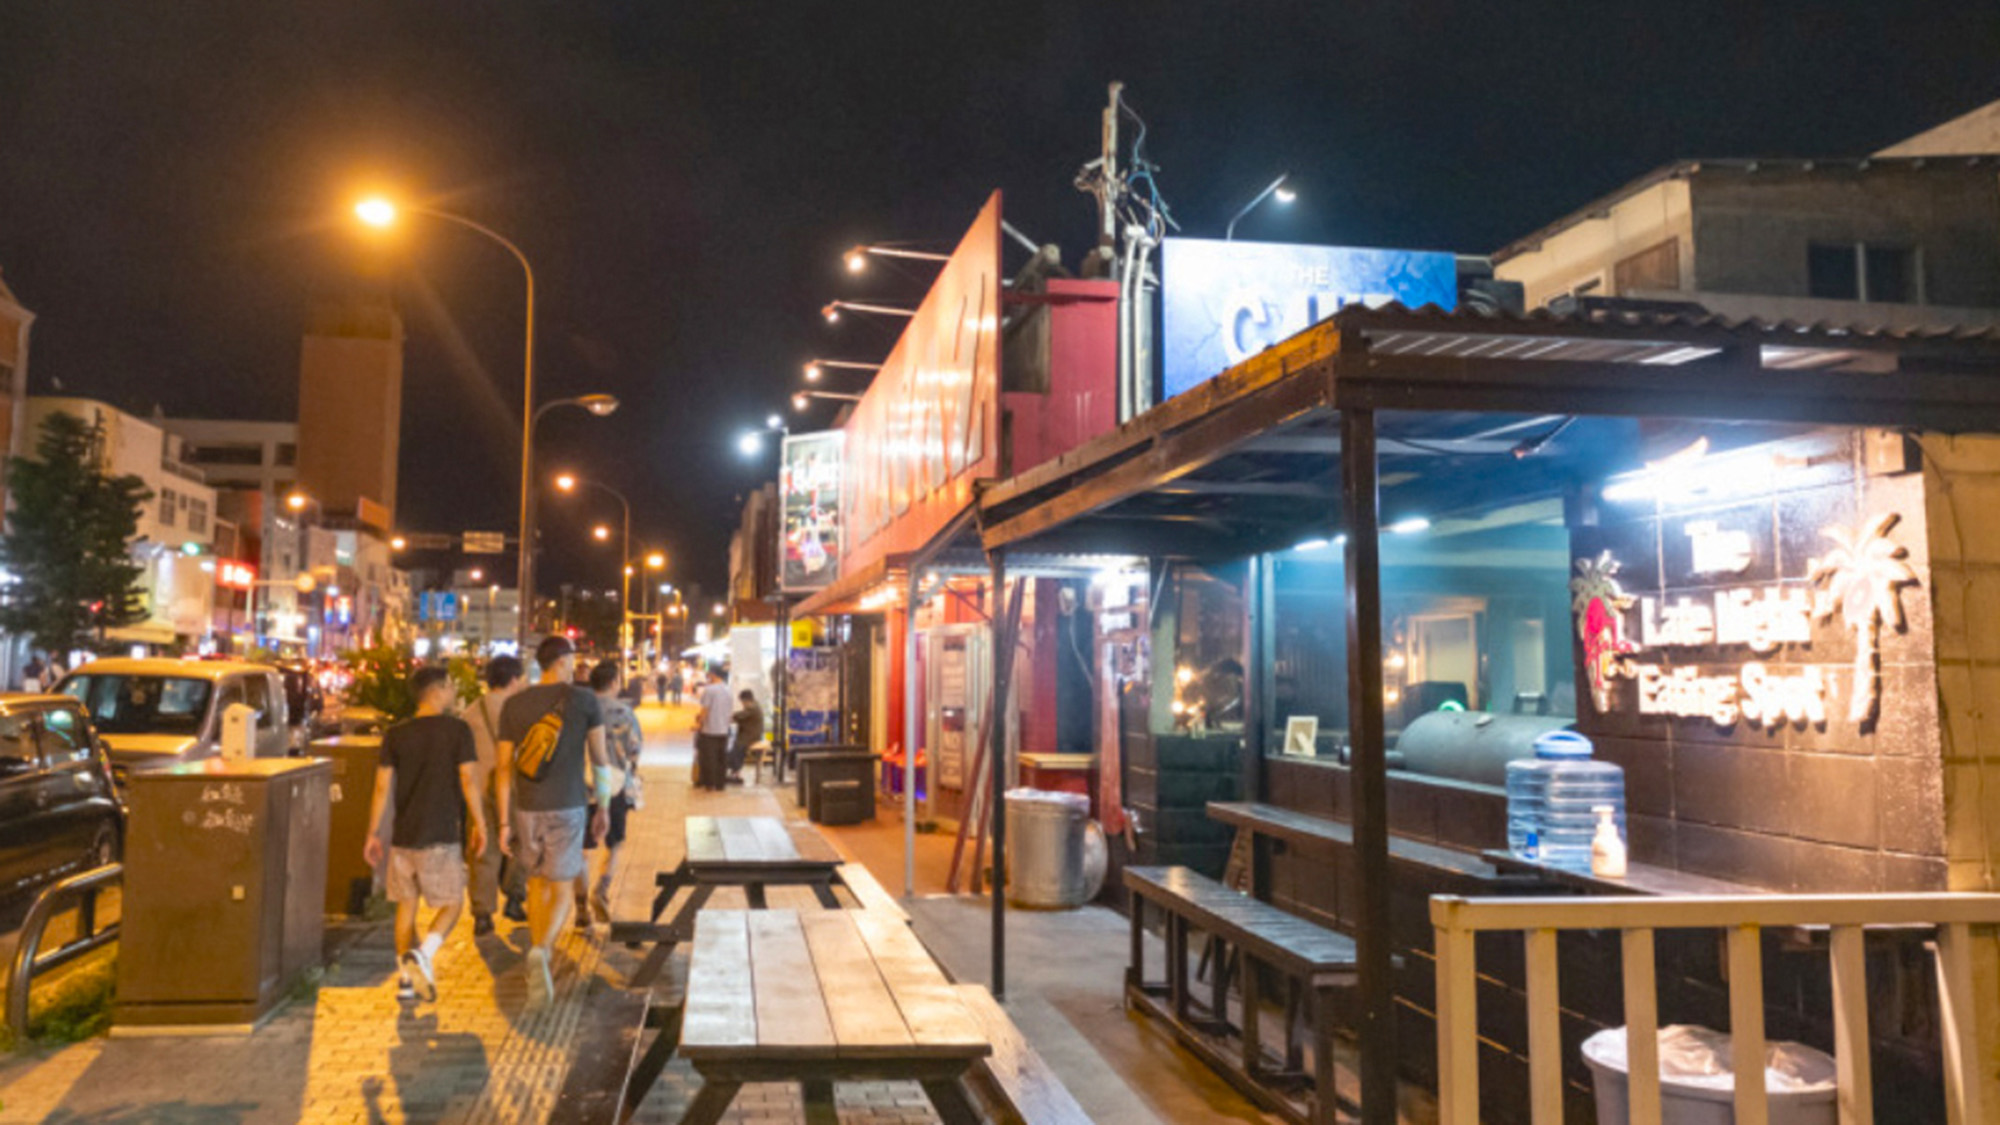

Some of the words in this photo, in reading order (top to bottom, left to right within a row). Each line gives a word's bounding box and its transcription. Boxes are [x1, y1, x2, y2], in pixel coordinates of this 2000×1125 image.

[1684, 520, 1751, 574] The
[1641, 597, 1713, 645] Late
[1714, 587, 1812, 651] Night
[1638, 664, 1739, 726] Eating
[1740, 661, 1825, 727] Spot
